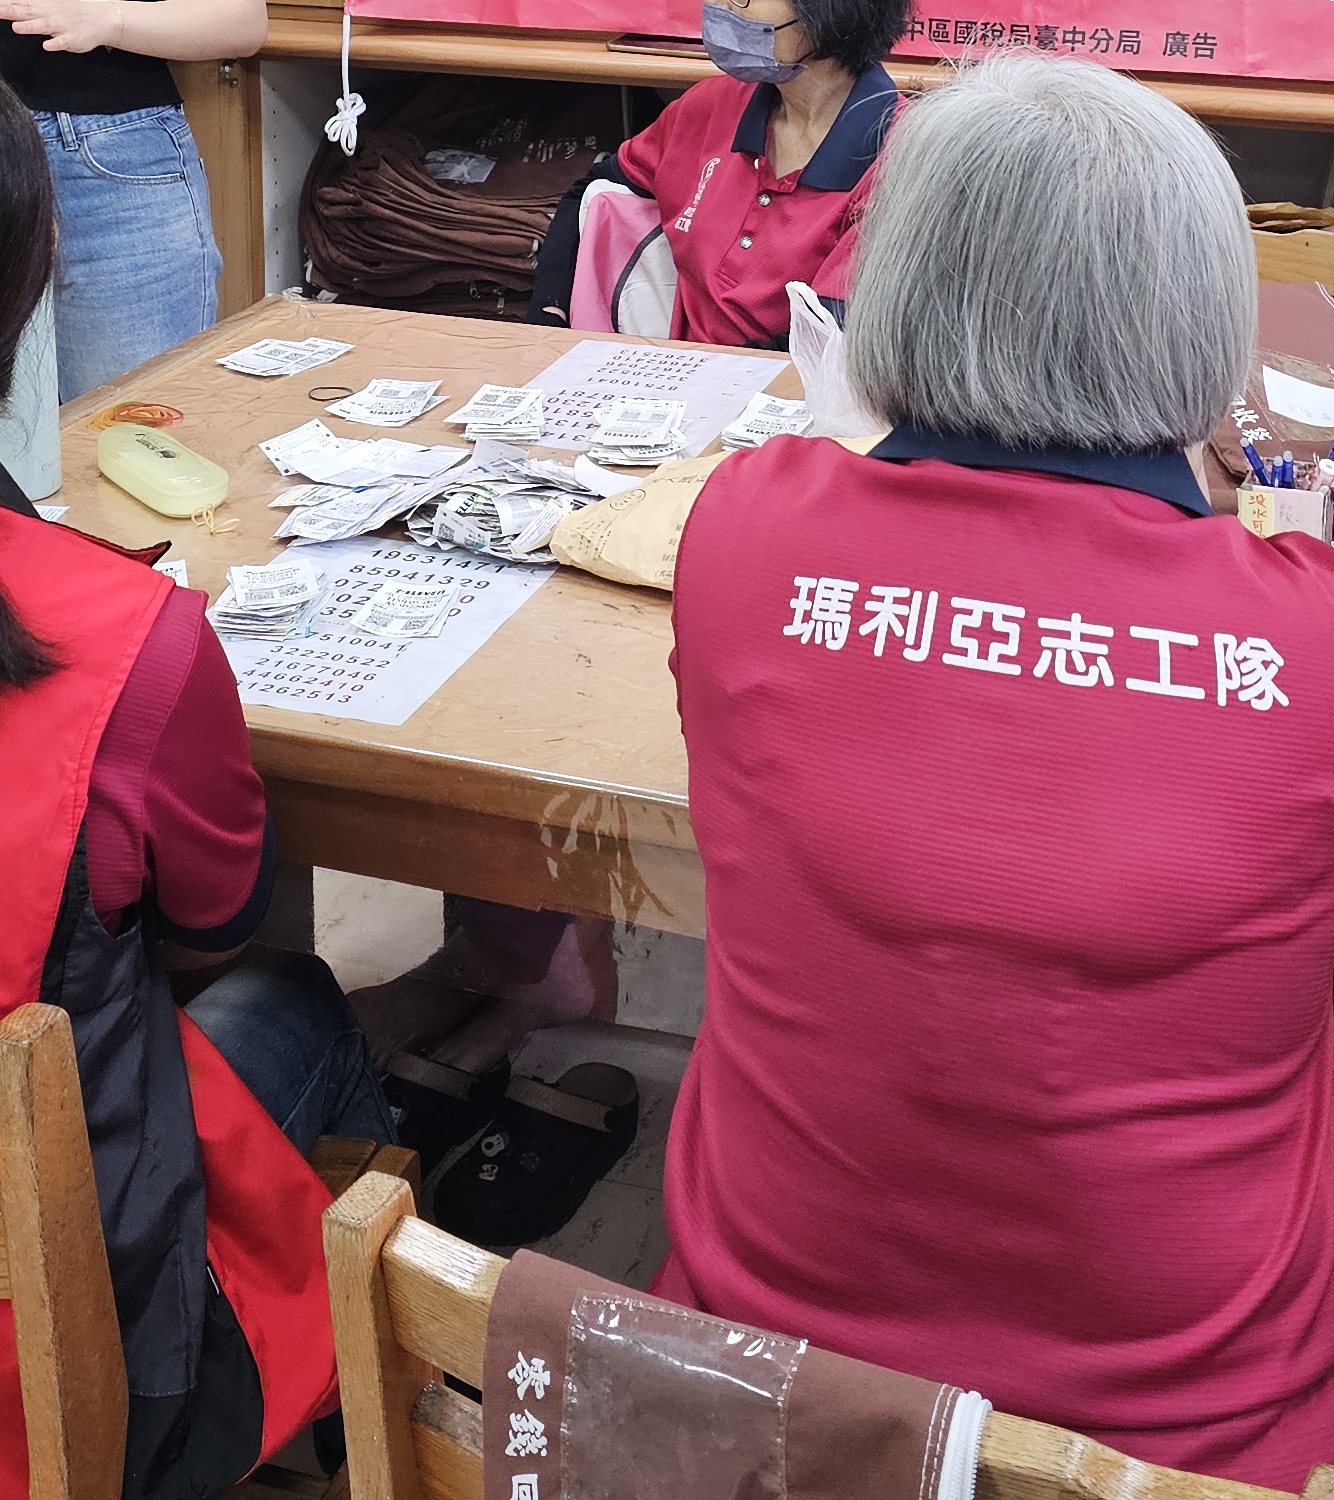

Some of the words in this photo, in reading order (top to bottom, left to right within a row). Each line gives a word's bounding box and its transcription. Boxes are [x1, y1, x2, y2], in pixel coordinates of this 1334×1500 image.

[1162, 32, 1218, 61] 廣告
[349, 564, 490, 589] 85941329
[783, 575, 1290, 712] 瑪利亞志工隊
[255, 657, 377, 681] 21677046
[270, 645, 390, 669] 32220522
[242, 668, 364, 692] 44662410
